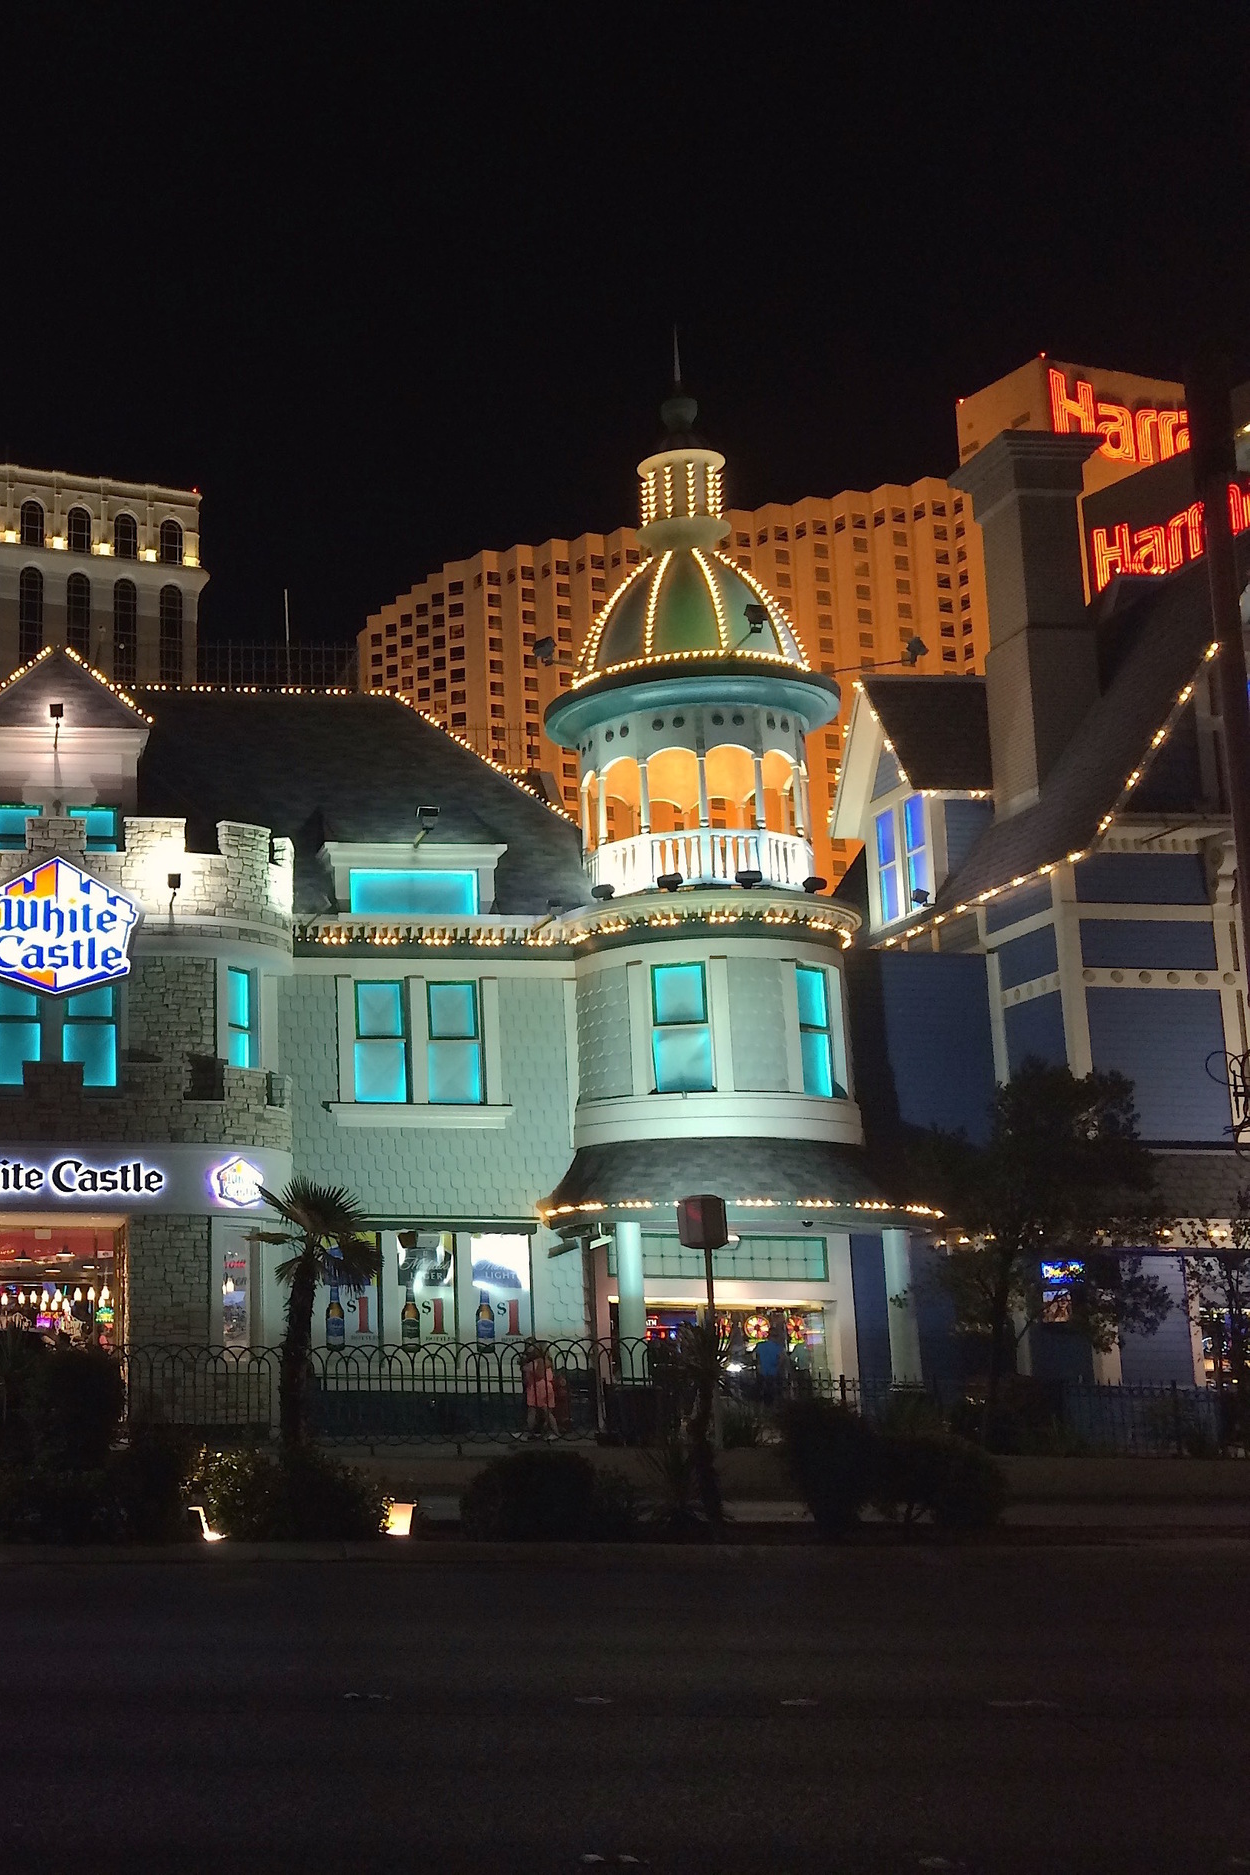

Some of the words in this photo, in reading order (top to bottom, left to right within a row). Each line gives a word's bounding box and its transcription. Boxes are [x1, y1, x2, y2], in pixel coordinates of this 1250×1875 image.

[52, 1159, 164, 1193] Castle
[410, 1271, 443, 1280] LGER
[485, 1271, 516, 1280] LIGHT
[421, 1298, 449, 1335] $1
[497, 1299, 523, 1336] $1
